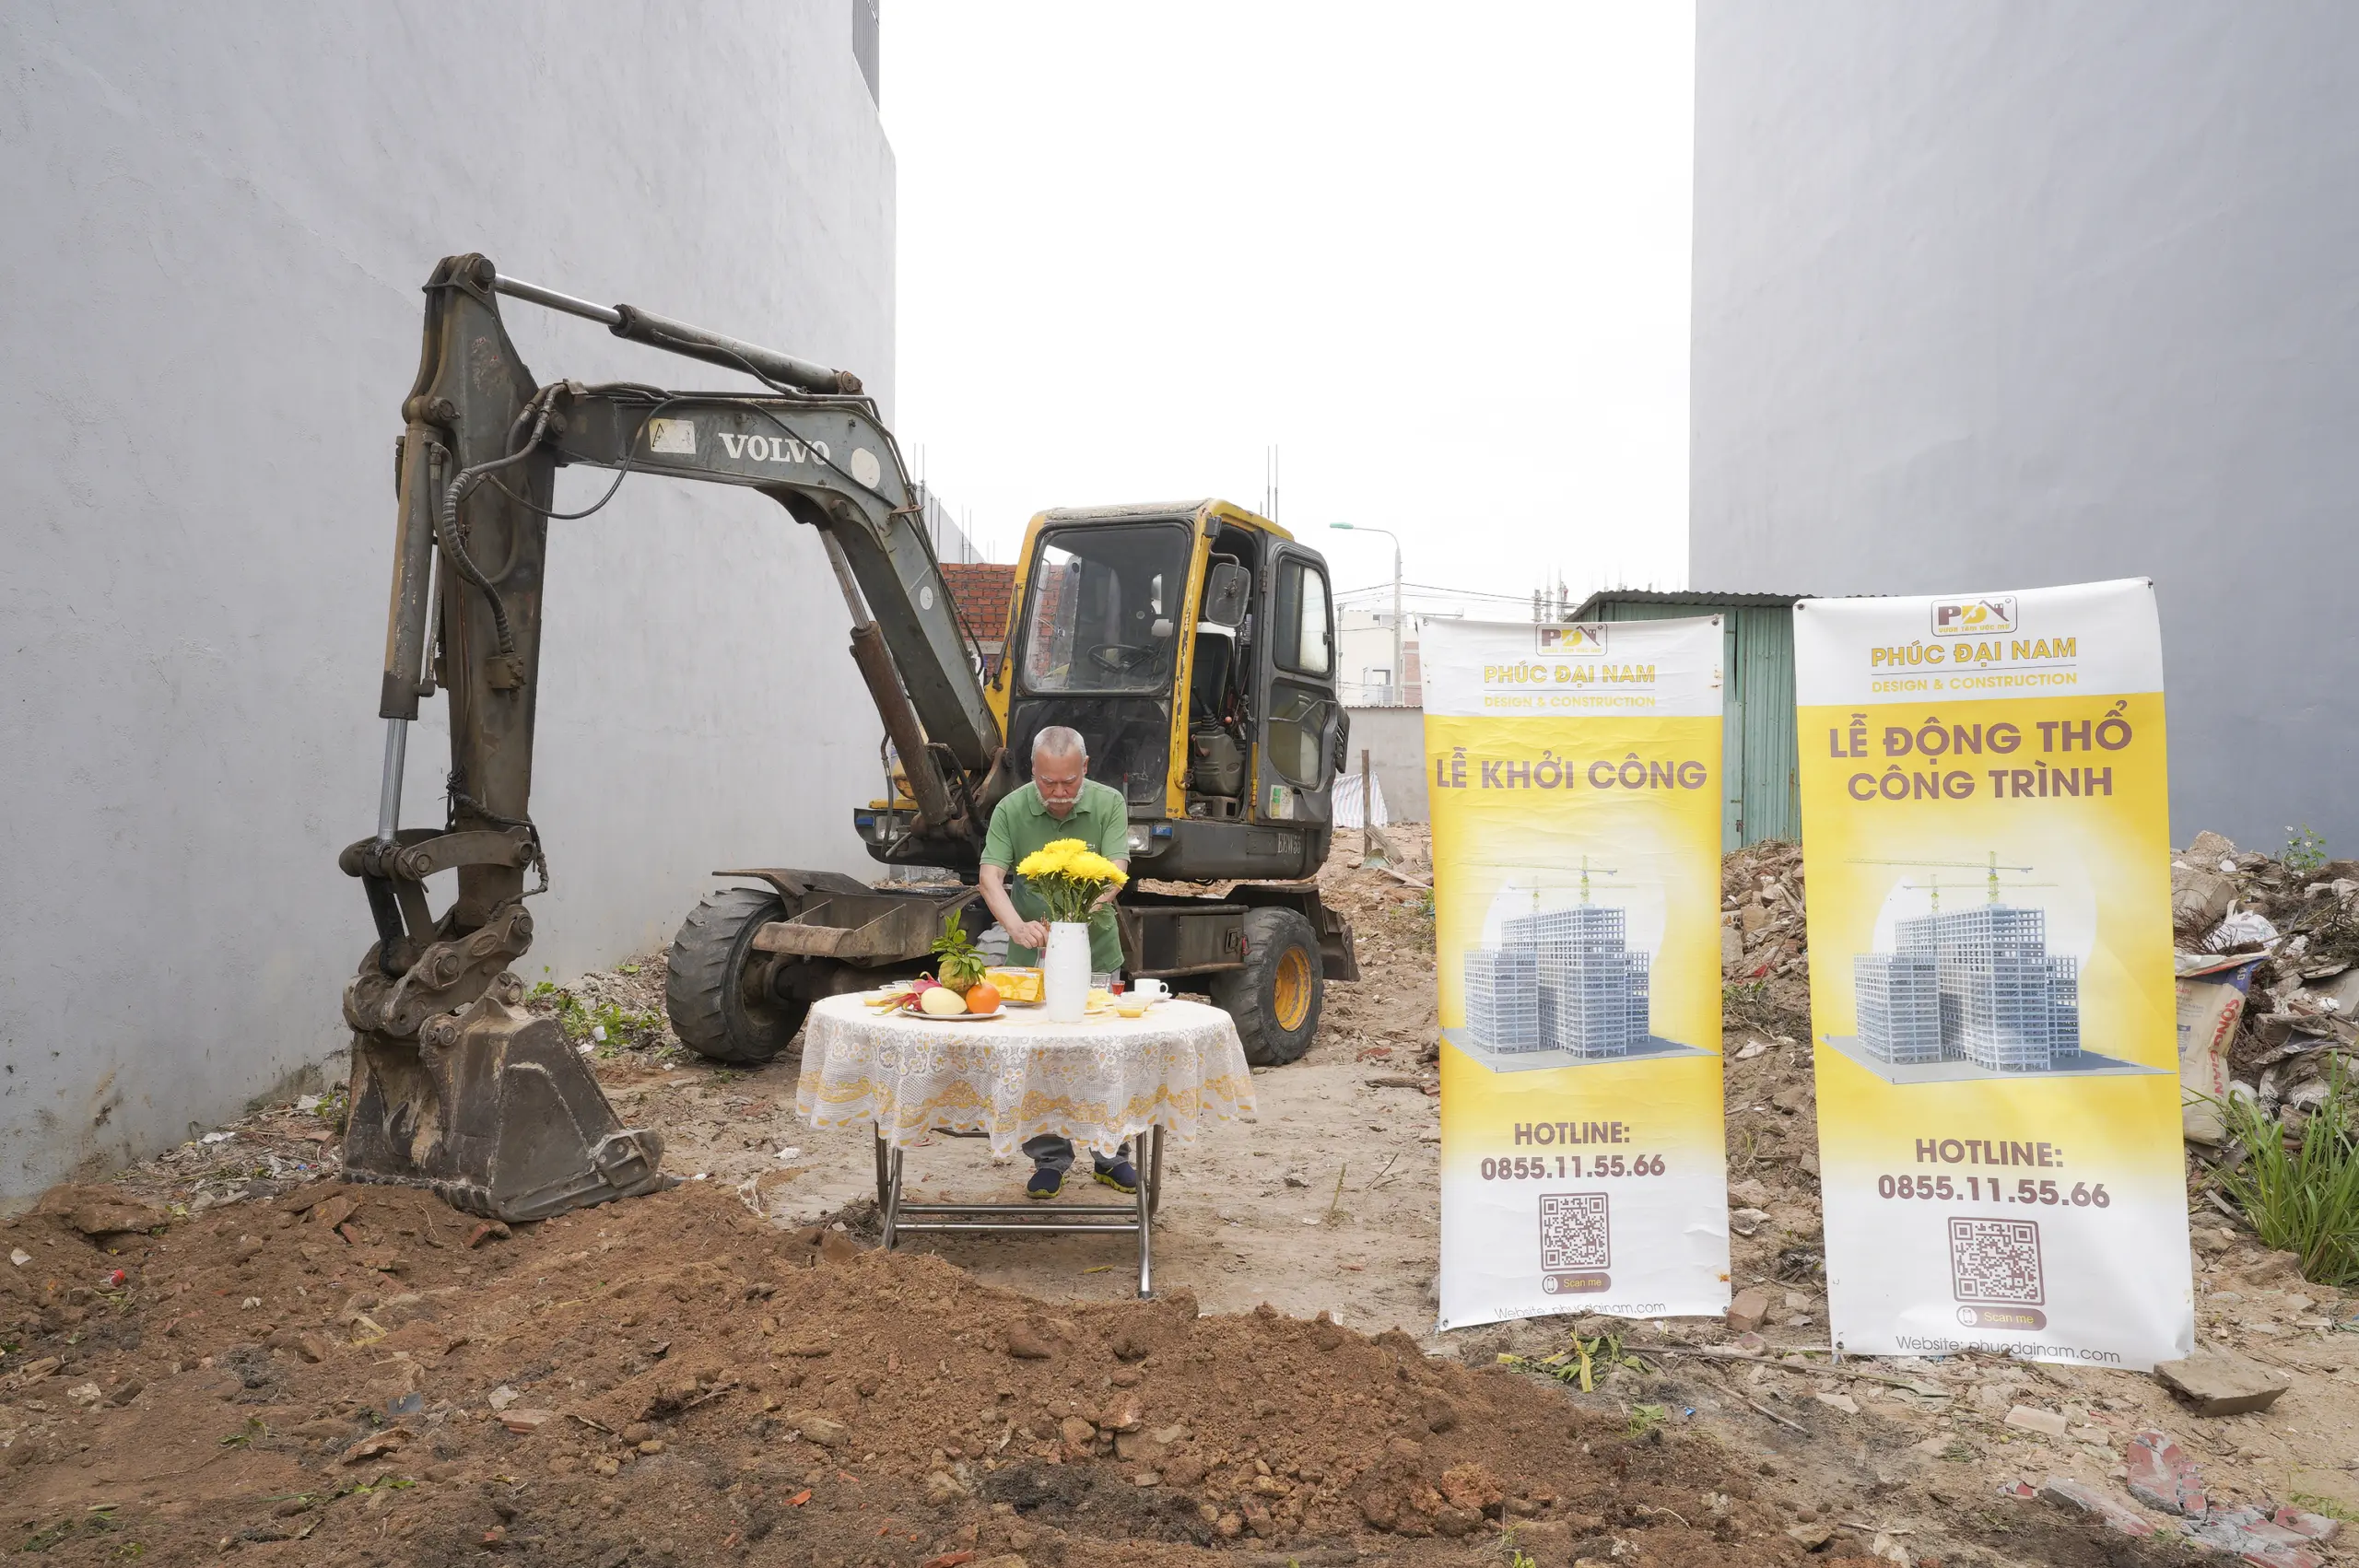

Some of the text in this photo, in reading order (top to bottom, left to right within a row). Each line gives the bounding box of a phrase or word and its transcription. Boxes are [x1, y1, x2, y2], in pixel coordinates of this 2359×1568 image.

[719, 432, 829, 464] VOLVO
[1871, 638, 2077, 667] PHÚC ĐẠI NAM
[1484, 661, 1656, 688] PHÚC ĐẠI NAM
[1872, 673, 2078, 693] DESIGN & CONSTRUCTION
[1484, 696, 1656, 708] DESIGN & CONSTRUCTION
[1829, 700, 2133, 766] LỄ ĐỘNG THỔ
[1437, 746, 1708, 790] LỄ KHỞI CÔNG
[1848, 759, 2113, 802] CÔNG TRÌNH
[2213, 999, 2240, 1047] SÔNG
[1514, 1122, 1630, 1145] HOTLINE:
[1481, 1153, 1666, 1181] 0855.11.55.66
[1915, 1139, 2064, 1167] HOTLINE:
[1878, 1175, 2110, 1209] 0855.11.55.66
[1564, 1278, 1586, 1288] Scan
[1984, 1311, 2035, 1324] Scan me
[1895, 1336, 1964, 1352] Website:
